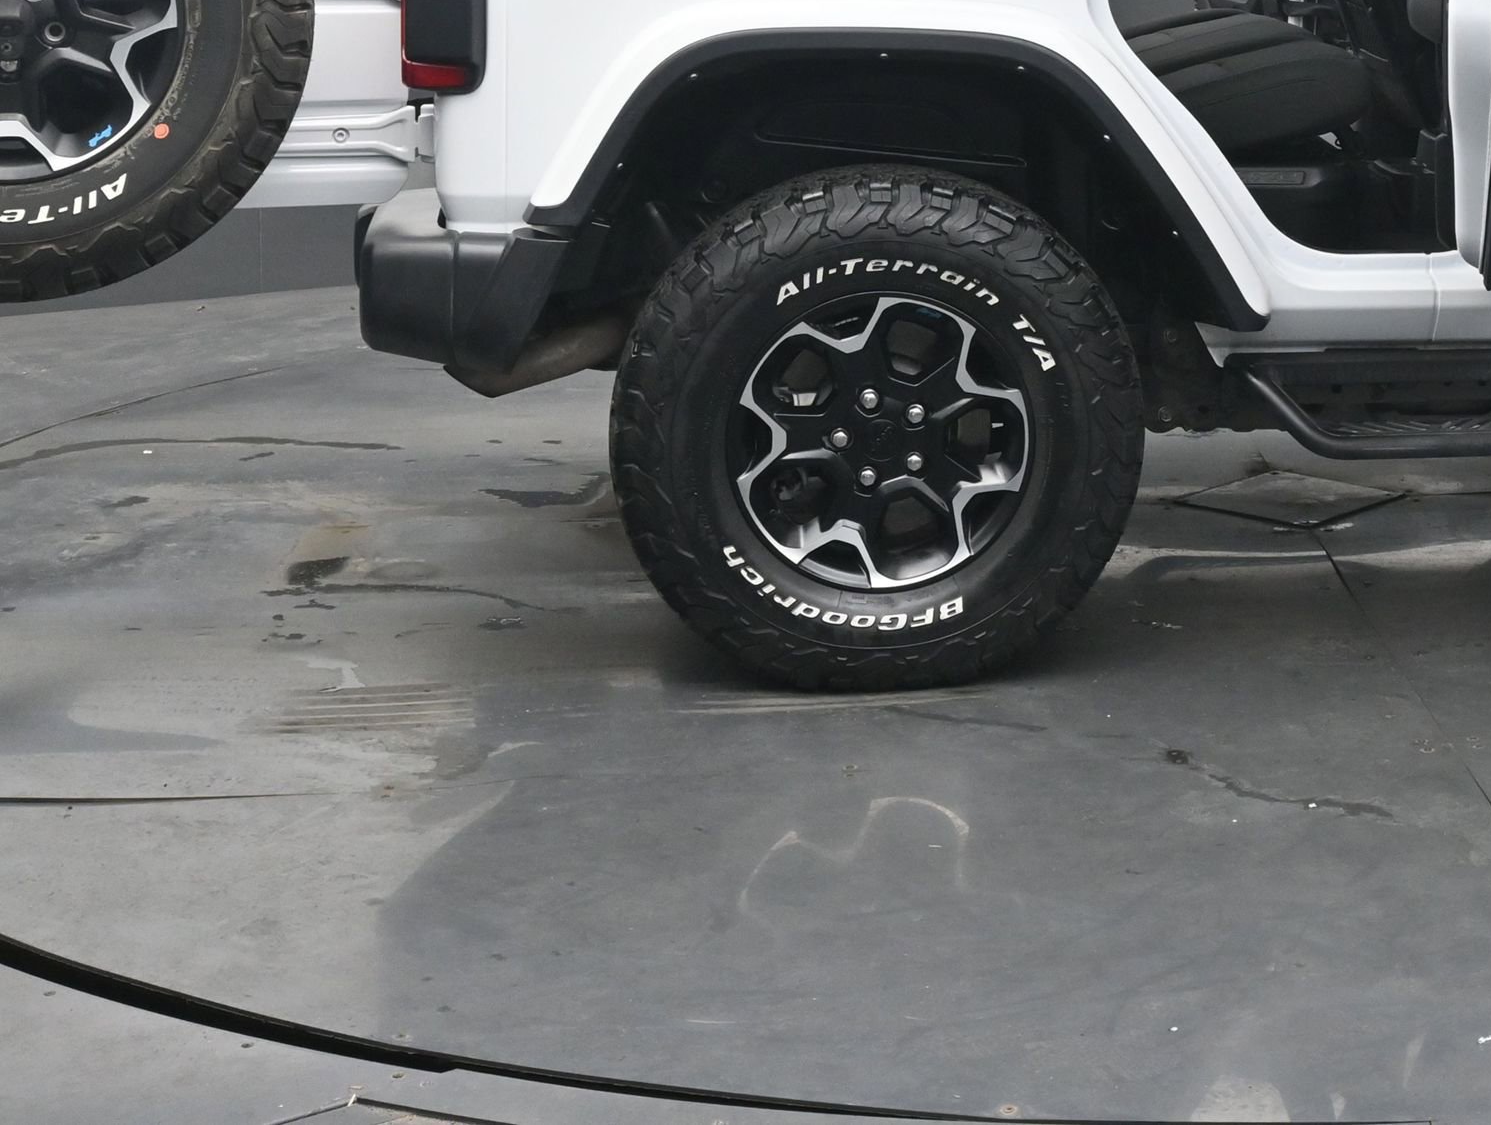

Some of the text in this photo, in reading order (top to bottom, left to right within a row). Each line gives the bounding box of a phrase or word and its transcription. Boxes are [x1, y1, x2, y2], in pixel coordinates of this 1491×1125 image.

[776, 257, 1056, 372] All-Terrain T/A
[723, 544, 964, 631] BFGoodrich
